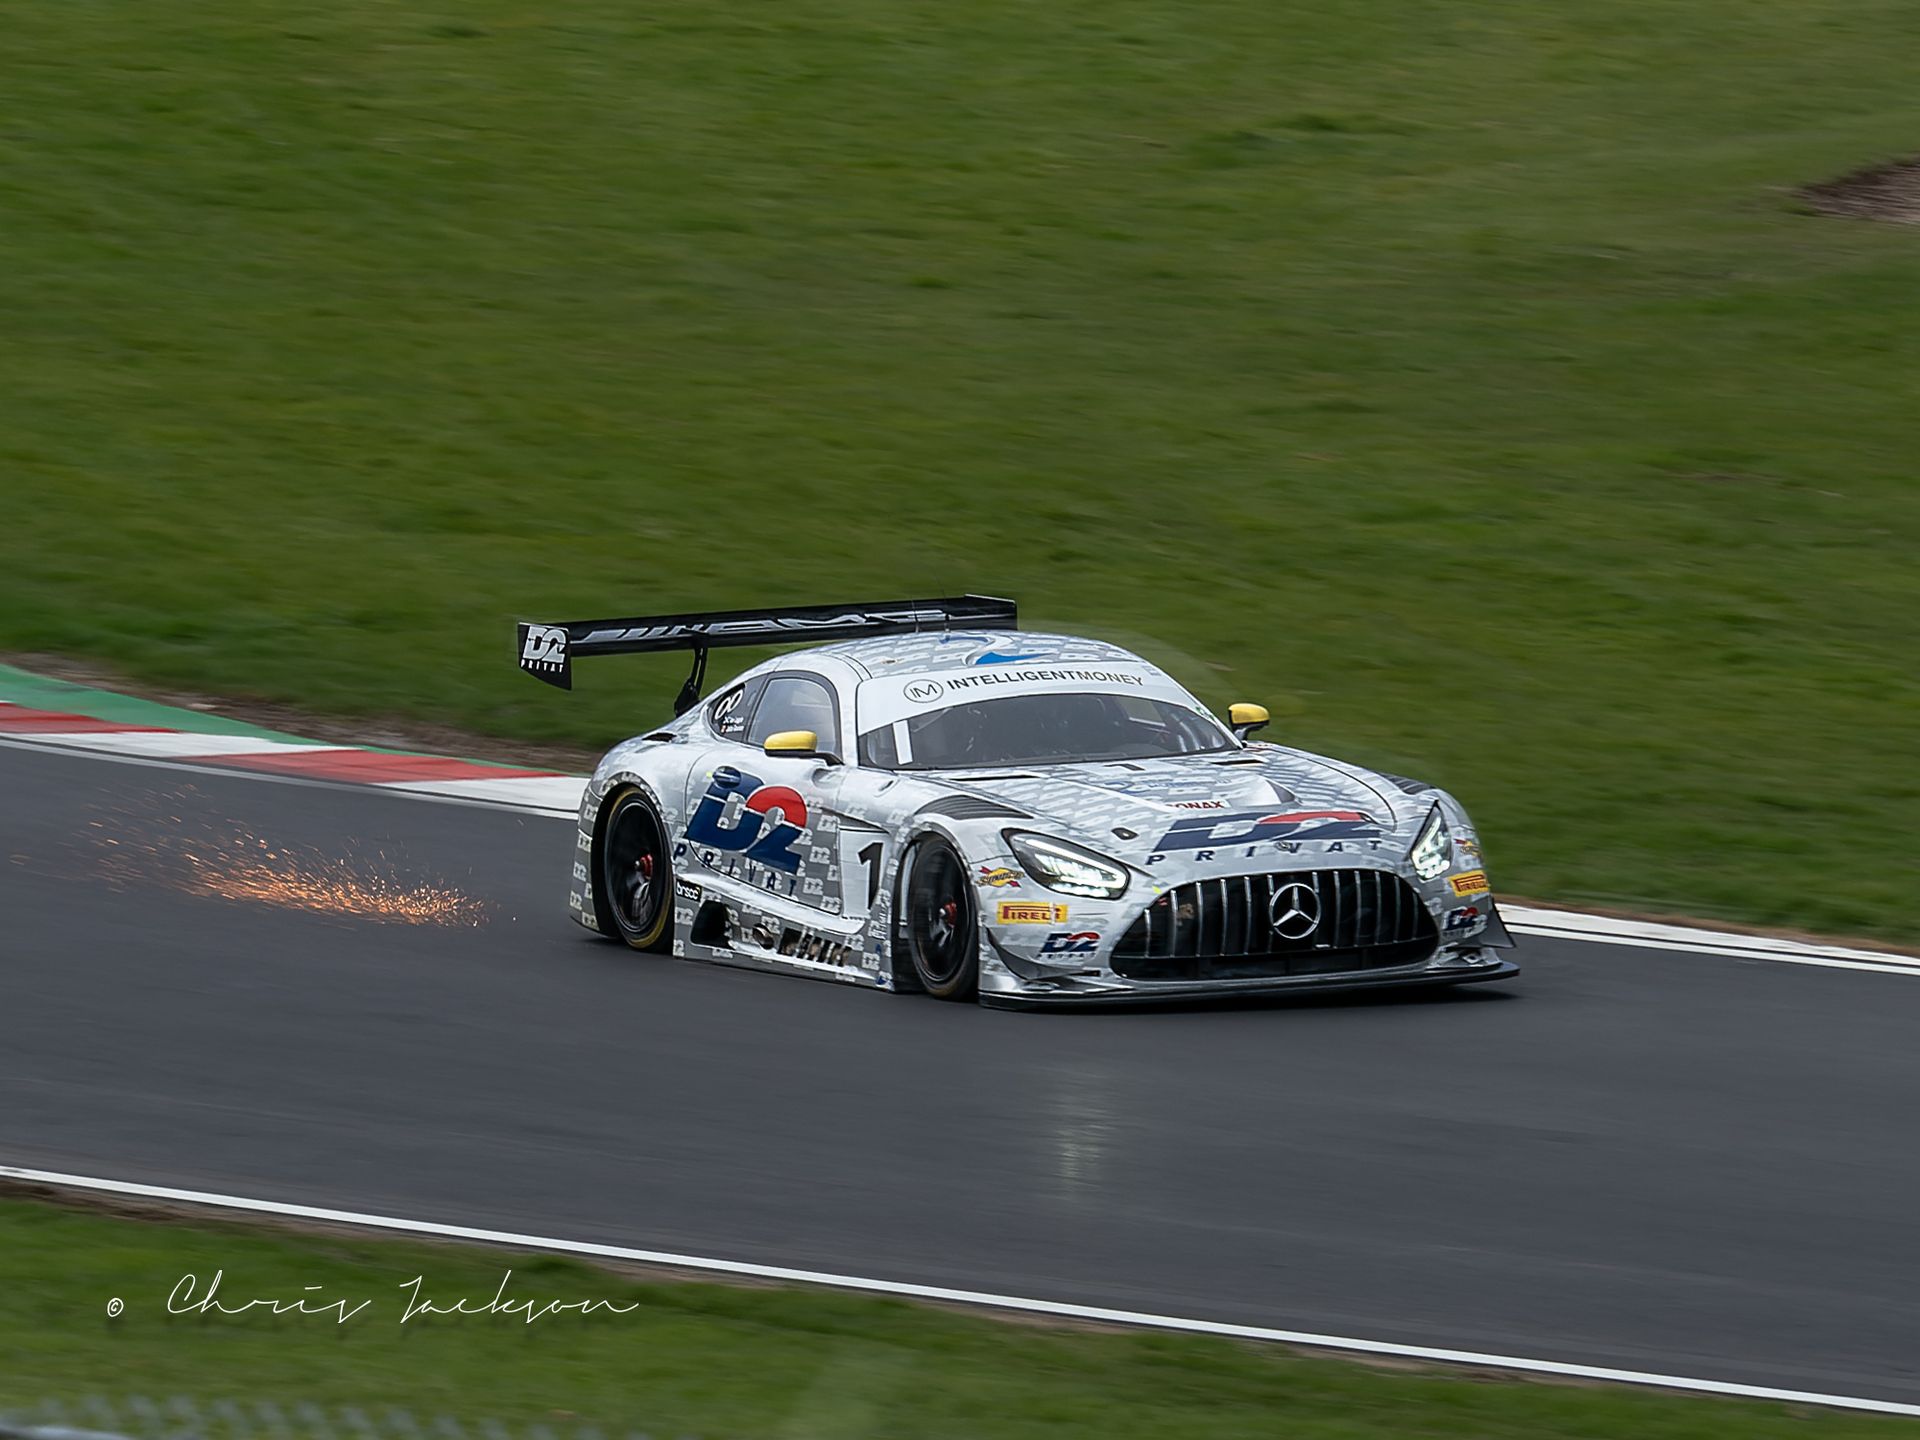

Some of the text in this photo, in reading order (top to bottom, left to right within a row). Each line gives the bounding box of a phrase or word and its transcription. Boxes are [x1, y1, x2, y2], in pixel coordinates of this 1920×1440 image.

[523, 626, 566, 662] D2
[947, 670, 1144, 690] INTELLIGENTMONEY
[1166, 801, 1224, 809] ONAX
[1152, 811, 1380, 853] D2
[1145, 840, 1383, 866] PRIVAT
[673, 842, 797, 897] PRIVAT
[857, 841, 884, 910] 1
[1002, 905, 1061, 920] PIRELI
[1040, 932, 1100, 953] D2
